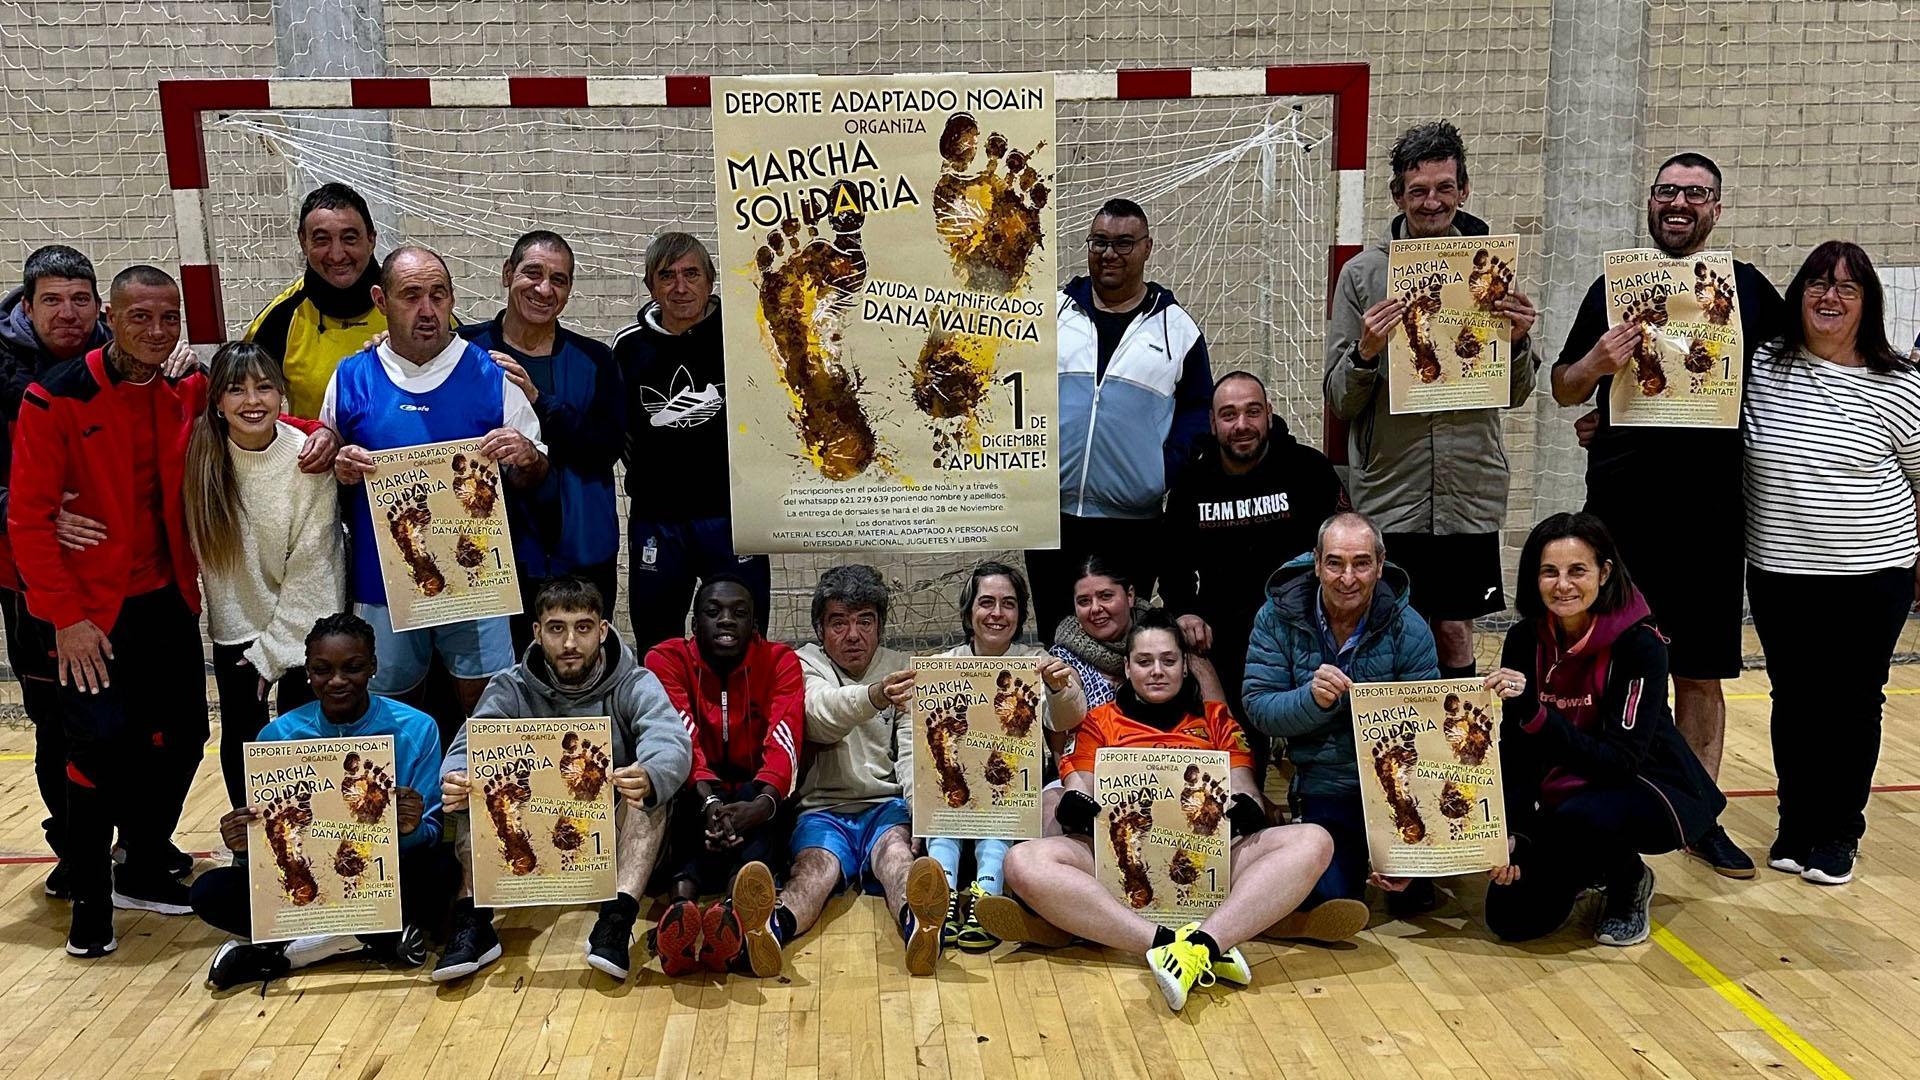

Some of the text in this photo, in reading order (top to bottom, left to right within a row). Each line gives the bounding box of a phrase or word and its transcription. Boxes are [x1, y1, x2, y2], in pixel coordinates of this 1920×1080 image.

[725, 91, 822, 114] DEPORTE
[831, 89, 957, 113] ADAPTADO
[726, 139, 879, 191] MARCHA
[1395, 243, 1431, 252] DEPORTE
[1434, 241, 1481, 250] ADAPTADO
[1609, 253, 1649, 264] DEPORTE
[1393, 259, 1449, 278] MARCHA
[1611, 269, 1672, 293] MARCHA
[865, 281, 918, 300] AYUDA
[863, 300, 929, 328] DANA
[1439, 316, 1463, 326] DANA
[1666, 328, 1693, 338] DANA
[1489, 340, 1498, 362] 1
[1721, 357, 1730, 380] 1
[1002, 371, 1024, 430] 1
[1031, 416, 1047, 429] DE
[372, 443, 481, 465] EPORTE ADAPTADO NOA
[949, 452, 1047, 471] APUNTATE!
[370, 469, 429, 493] MARCHA
[790, 487, 843, 495] Inscripciones
[868, 484, 920, 493] polideportivo
[974, 482, 998, 490] través
[798, 497, 838, 505] whatsapp
[1198, 502, 1234, 521] TEAM
[432, 526, 458, 534] DANA
[872, 518, 911, 526] donativos
[901, 527, 945, 535] ADAPTADO
[906, 537, 948, 545] JUGUETES
[491, 547, 501, 569] 1
[956, 662, 1003, 670] ADAPTADO
[916, 679, 973, 697] MARCHA
[1355, 688, 1394, 697] DEPORTE
[1398, 686, 1449, 695] ADAPTADO
[1358, 705, 1419, 726] MARCHA
[472, 724, 512, 733] DEPORTE
[515, 724, 569, 732] ADAPTADO
[249, 747, 291, 757] DEPORTE
[295, 743, 350, 754] ADAPTADO
[472, 743, 535, 763] MARCHA
[966, 739, 992, 749] DANA
[1101, 754, 1138, 762] DEPORTE
[1142, 754, 1191, 763] ADAPTADO
[251, 764, 316, 787] MARCHA
[1020, 769, 1028, 791] 1
[1100, 773, 1159, 789] MARCHA
[1417, 769, 1445, 780] DANA
[530, 805, 559, 815] DANA
[1479, 798, 1489, 822] 1
[311, 829, 341, 840] DANA
[591, 832, 601, 855] 1
[1150, 836, 1177, 848] DANA
[374, 857, 384, 881] 1
[1207, 868, 1216, 892] 1
